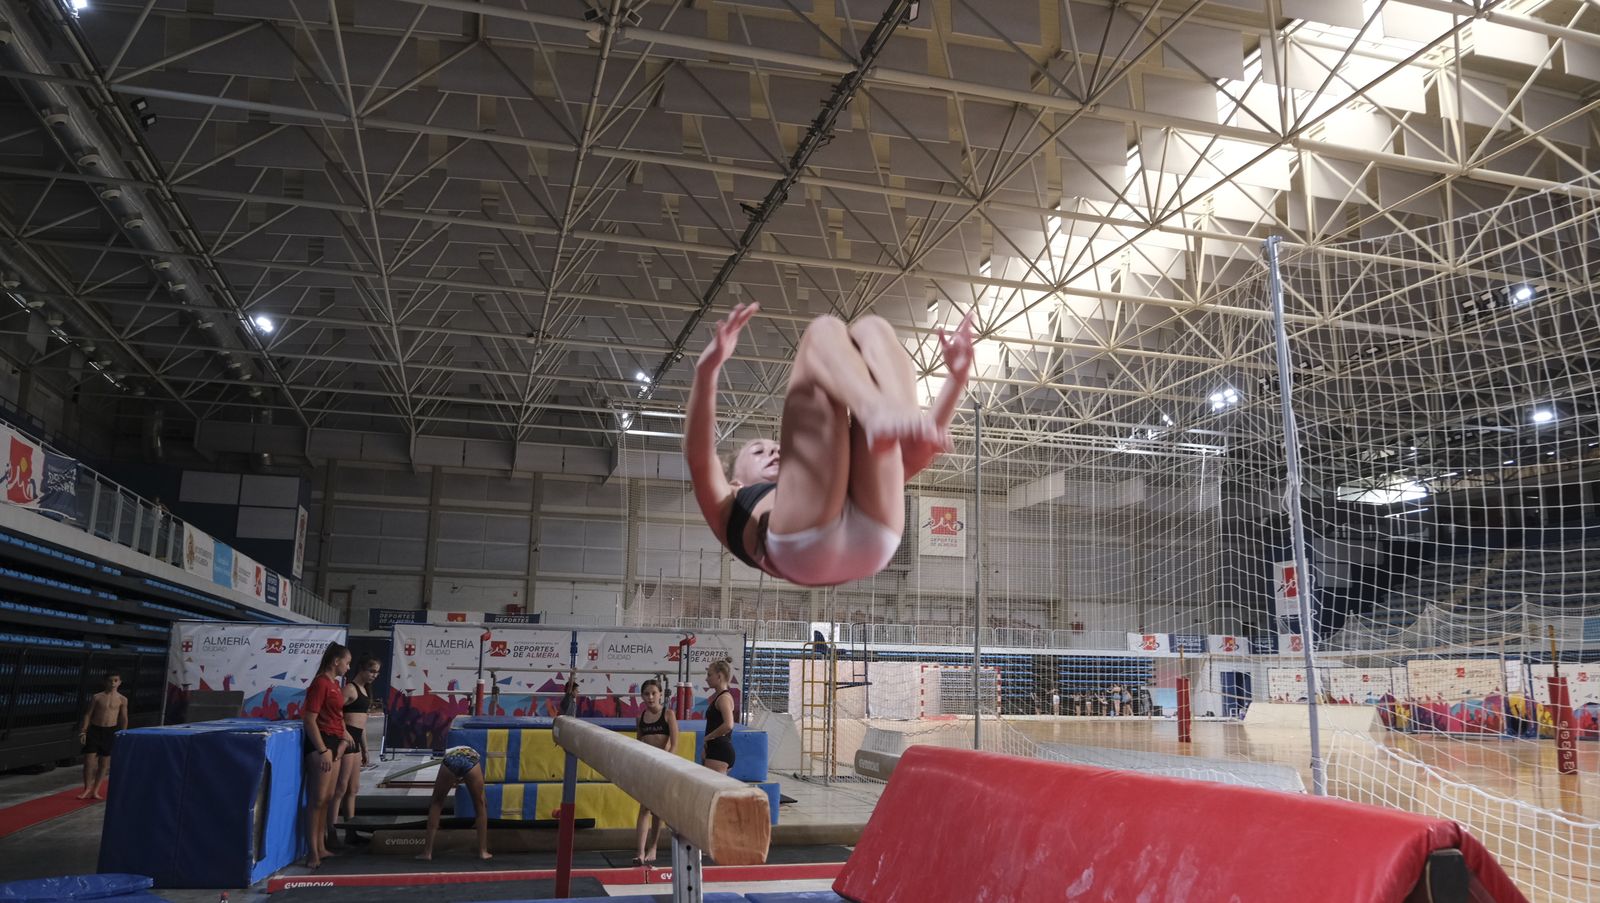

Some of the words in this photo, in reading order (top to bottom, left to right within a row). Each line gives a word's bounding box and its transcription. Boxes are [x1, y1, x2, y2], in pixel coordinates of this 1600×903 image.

[203, 635, 251, 646] ALMERÍA
[426, 638, 475, 649] ALMERÍA
[607, 642, 654, 654] ALMERÍA
